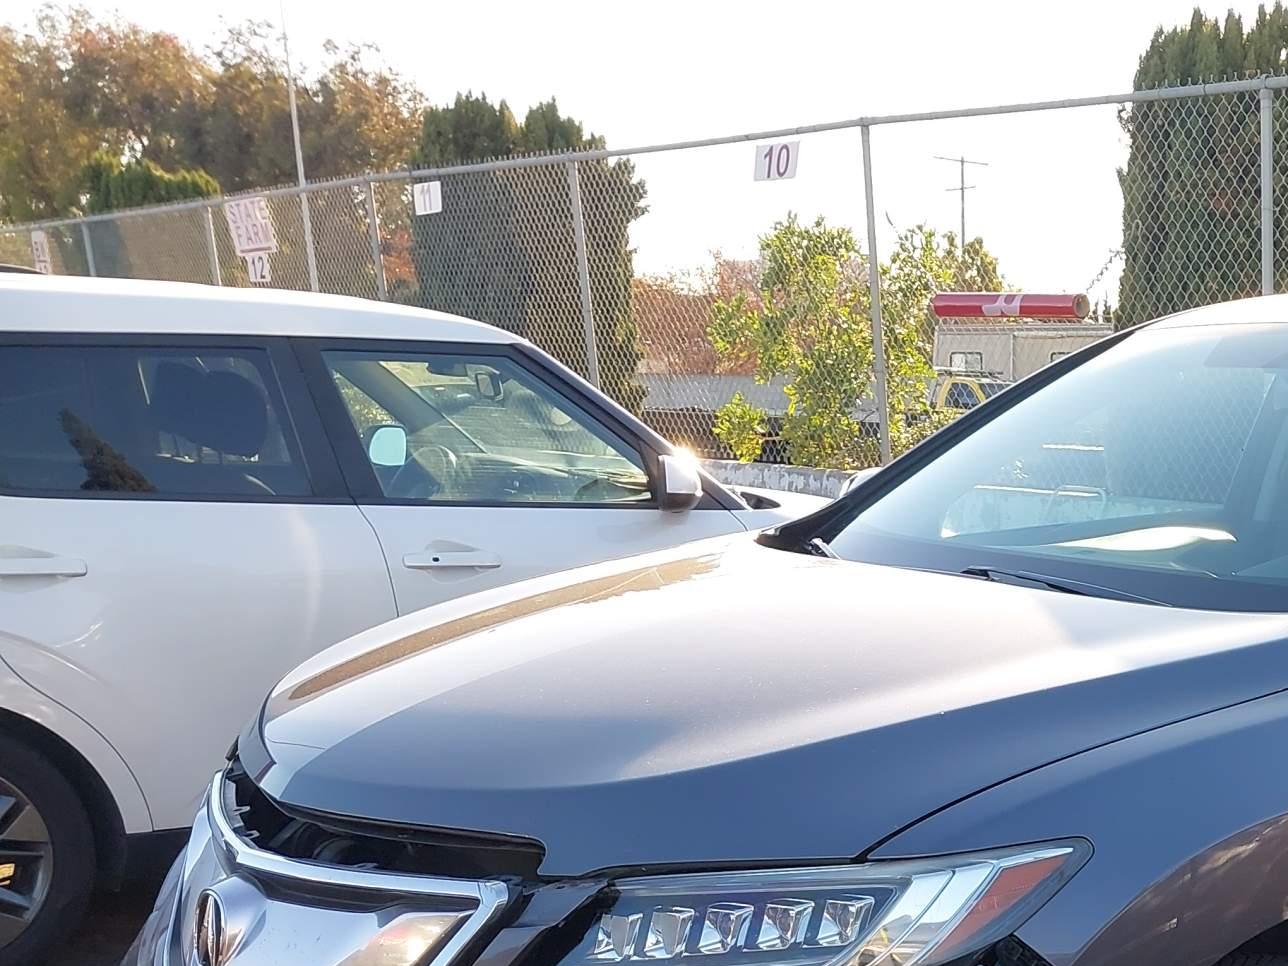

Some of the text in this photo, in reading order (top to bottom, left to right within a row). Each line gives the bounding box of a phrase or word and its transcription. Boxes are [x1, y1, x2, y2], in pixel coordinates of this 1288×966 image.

[763, 143, 790, 178] 10
[229, 199, 267, 224] STATE
[420, 183, 432, 212] 11
[235, 219, 271, 247] FARM
[251, 256, 266, 279] 12
